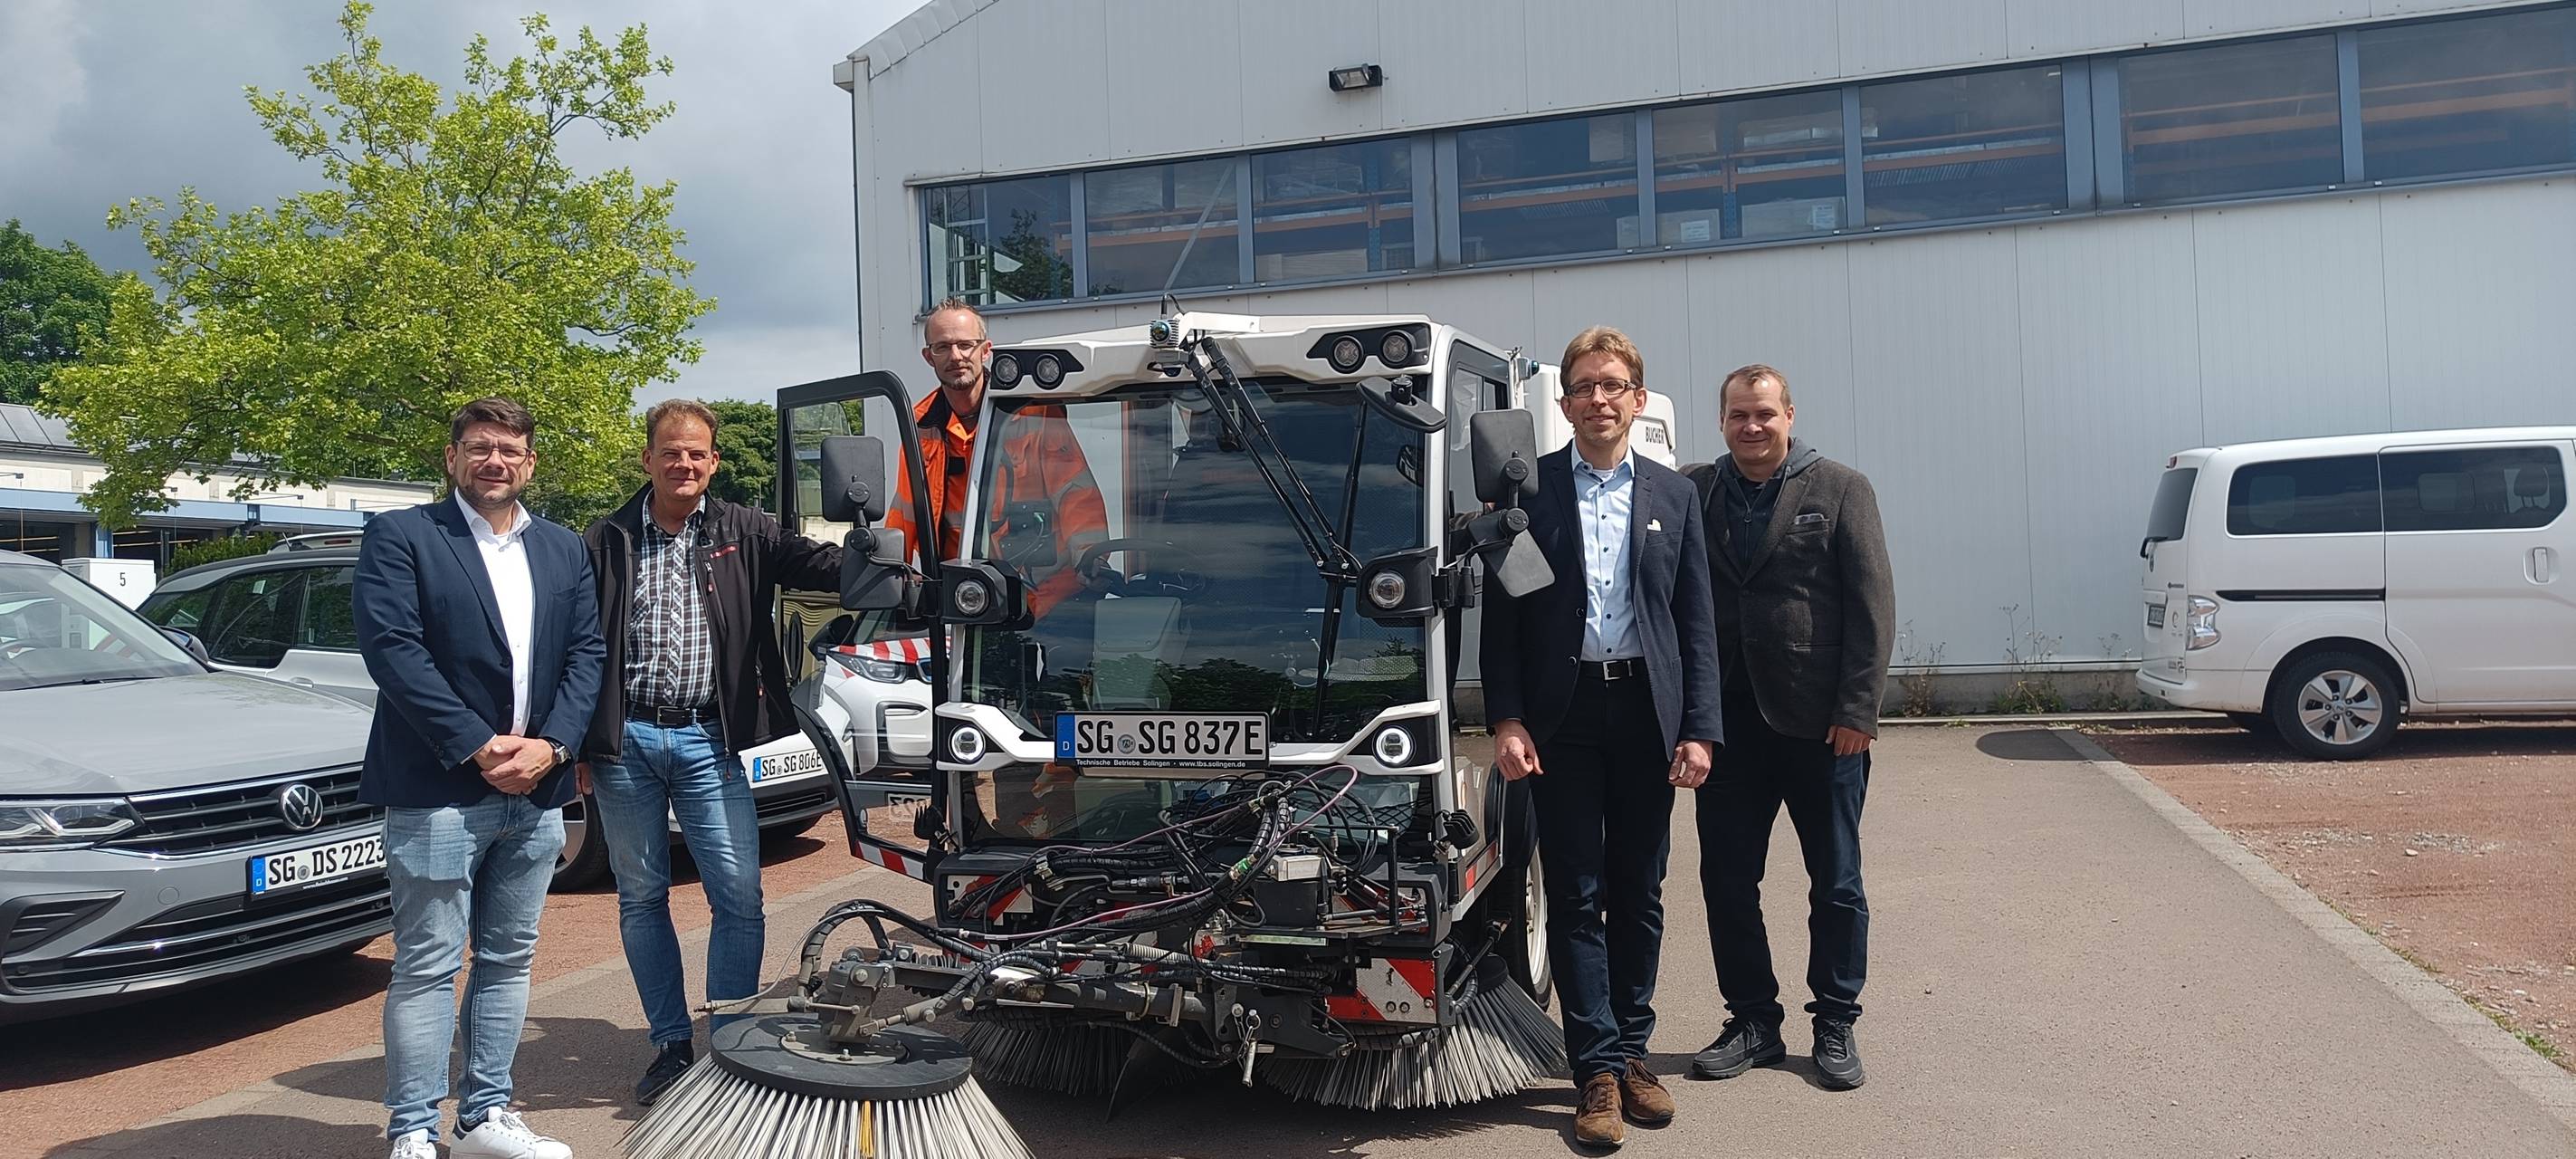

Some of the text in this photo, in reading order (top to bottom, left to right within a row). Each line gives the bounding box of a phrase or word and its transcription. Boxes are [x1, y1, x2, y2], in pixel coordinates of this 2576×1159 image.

[1646, 426, 1665, 444] BUCHER
[119, 572, 127, 587] 5
[1077, 720, 1264, 755] SG SG 837E
[1063, 742, 1070, 751] D
[762, 751, 822, 777] SG SG 806E
[1143, 760, 1170, 768] Solingen
[1178, 761, 1246, 769] www.tbs.solingen.de
[269, 856, 296, 886] SG
[312, 848, 338, 876] DS
[341, 838, 386, 870] 2223
[255, 878, 262, 886] D
